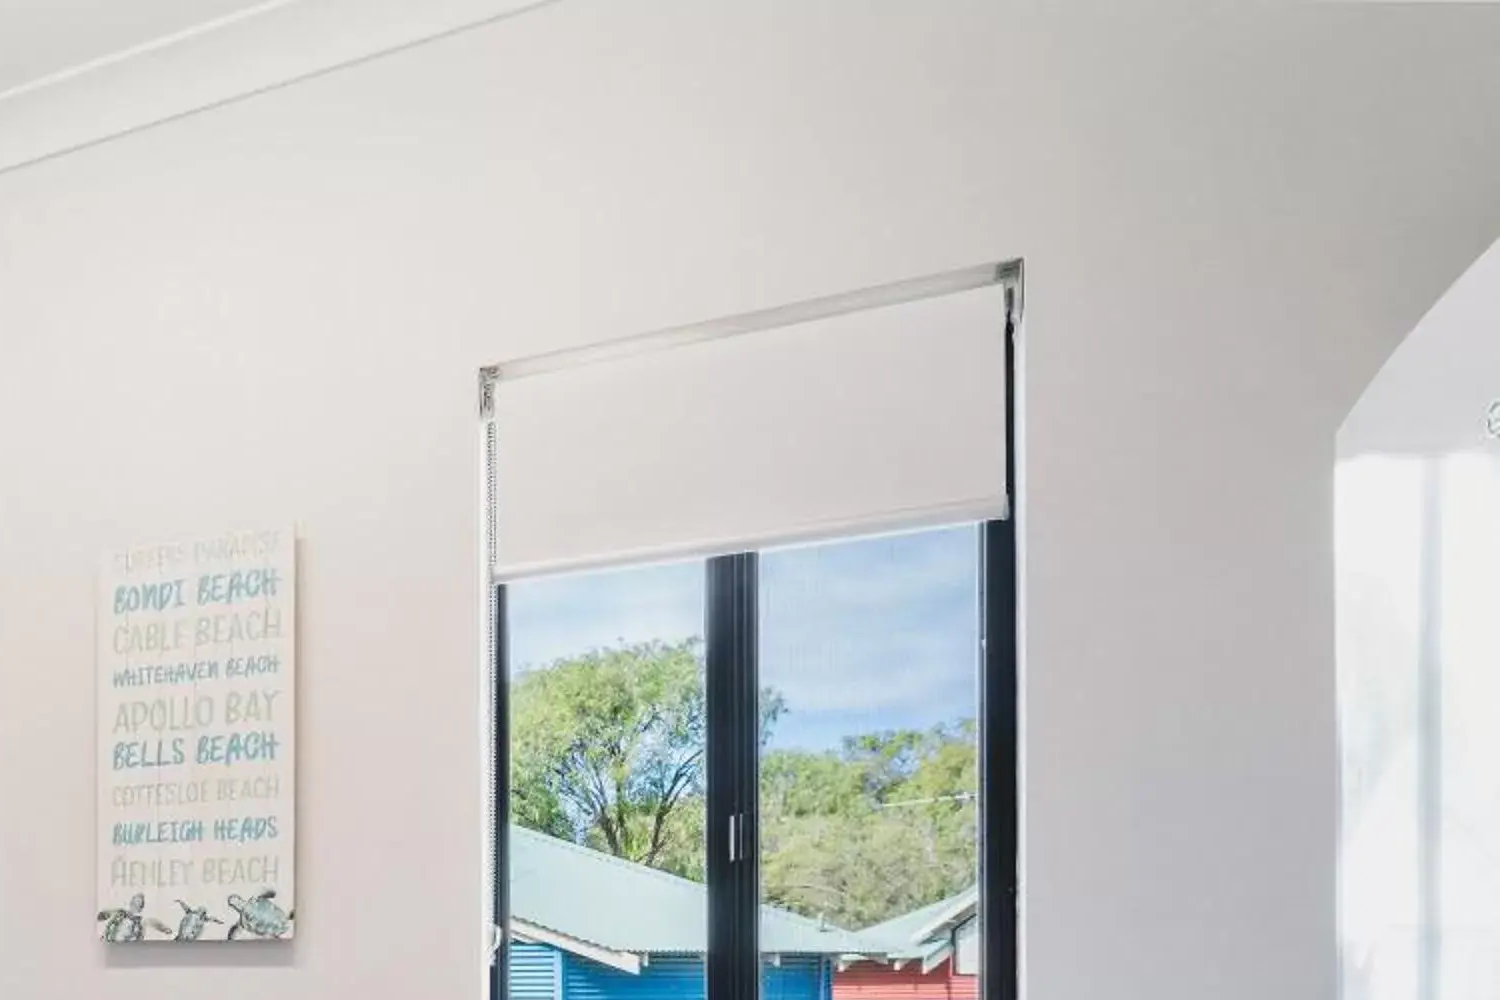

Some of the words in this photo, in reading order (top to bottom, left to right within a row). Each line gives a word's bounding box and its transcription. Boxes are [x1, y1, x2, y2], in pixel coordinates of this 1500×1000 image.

[113, 577, 187, 615] BONDI
[197, 567, 282, 607] BEACH
[112, 618, 187, 655] CABLE
[195, 607, 283, 647] BEACH
[113, 660, 219, 688] WHITEHAVEN
[226, 654, 281, 679] BEACH
[112, 695, 214, 734] APOLLO
[225, 688, 284, 726] BAY
[112, 738, 185, 771] BELLS
[196, 730, 281, 768] BEACH
[216, 775, 279, 801] BEACH
[113, 819, 204, 846] BURLEIGH
[213, 815, 279, 843] HEADS
[111, 855, 194, 888] HENLEY
[202, 855, 279, 885] BEACH
